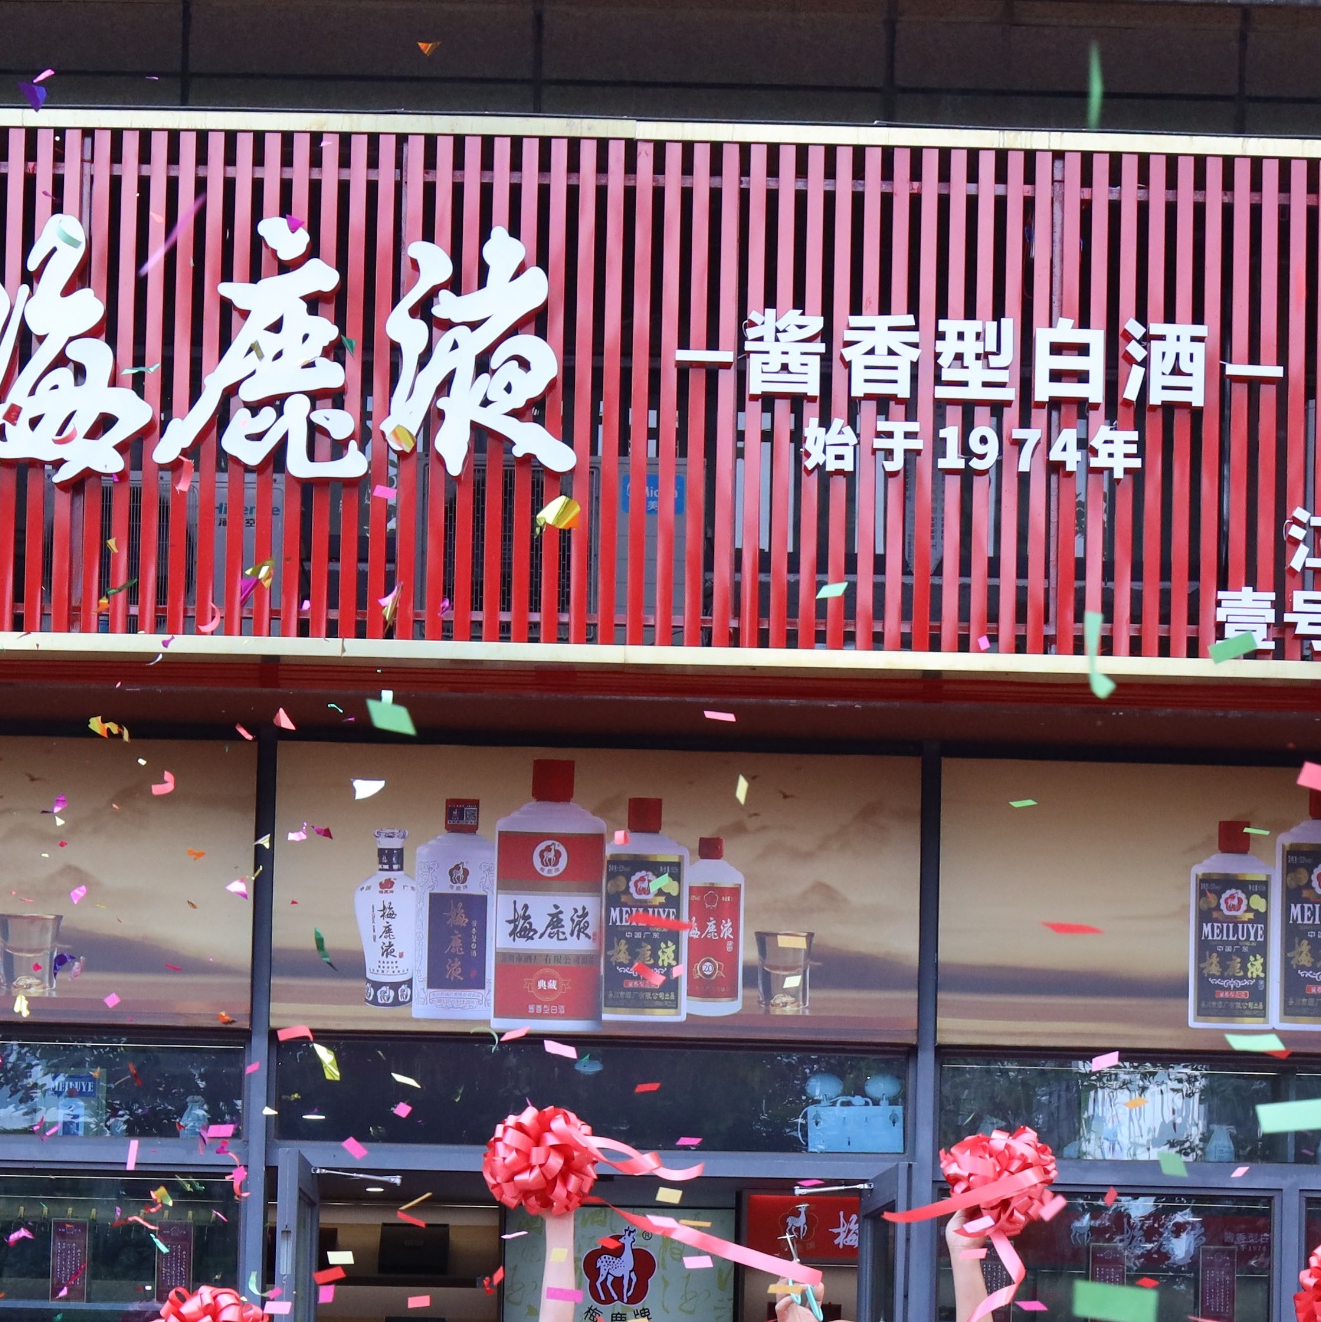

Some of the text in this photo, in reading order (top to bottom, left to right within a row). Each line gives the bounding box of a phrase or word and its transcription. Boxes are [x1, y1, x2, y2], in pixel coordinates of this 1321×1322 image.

[803, 417, 1142, 479] 始于1974年
[377, 900, 398, 959] 梅鹿液
[443, 900, 469, 981] 梅鹿液
[505, 899, 593, 943] 梅鹿液
[1201, 922, 1265, 942] MEILUYE
[537, 980, 558, 991] 典藏
